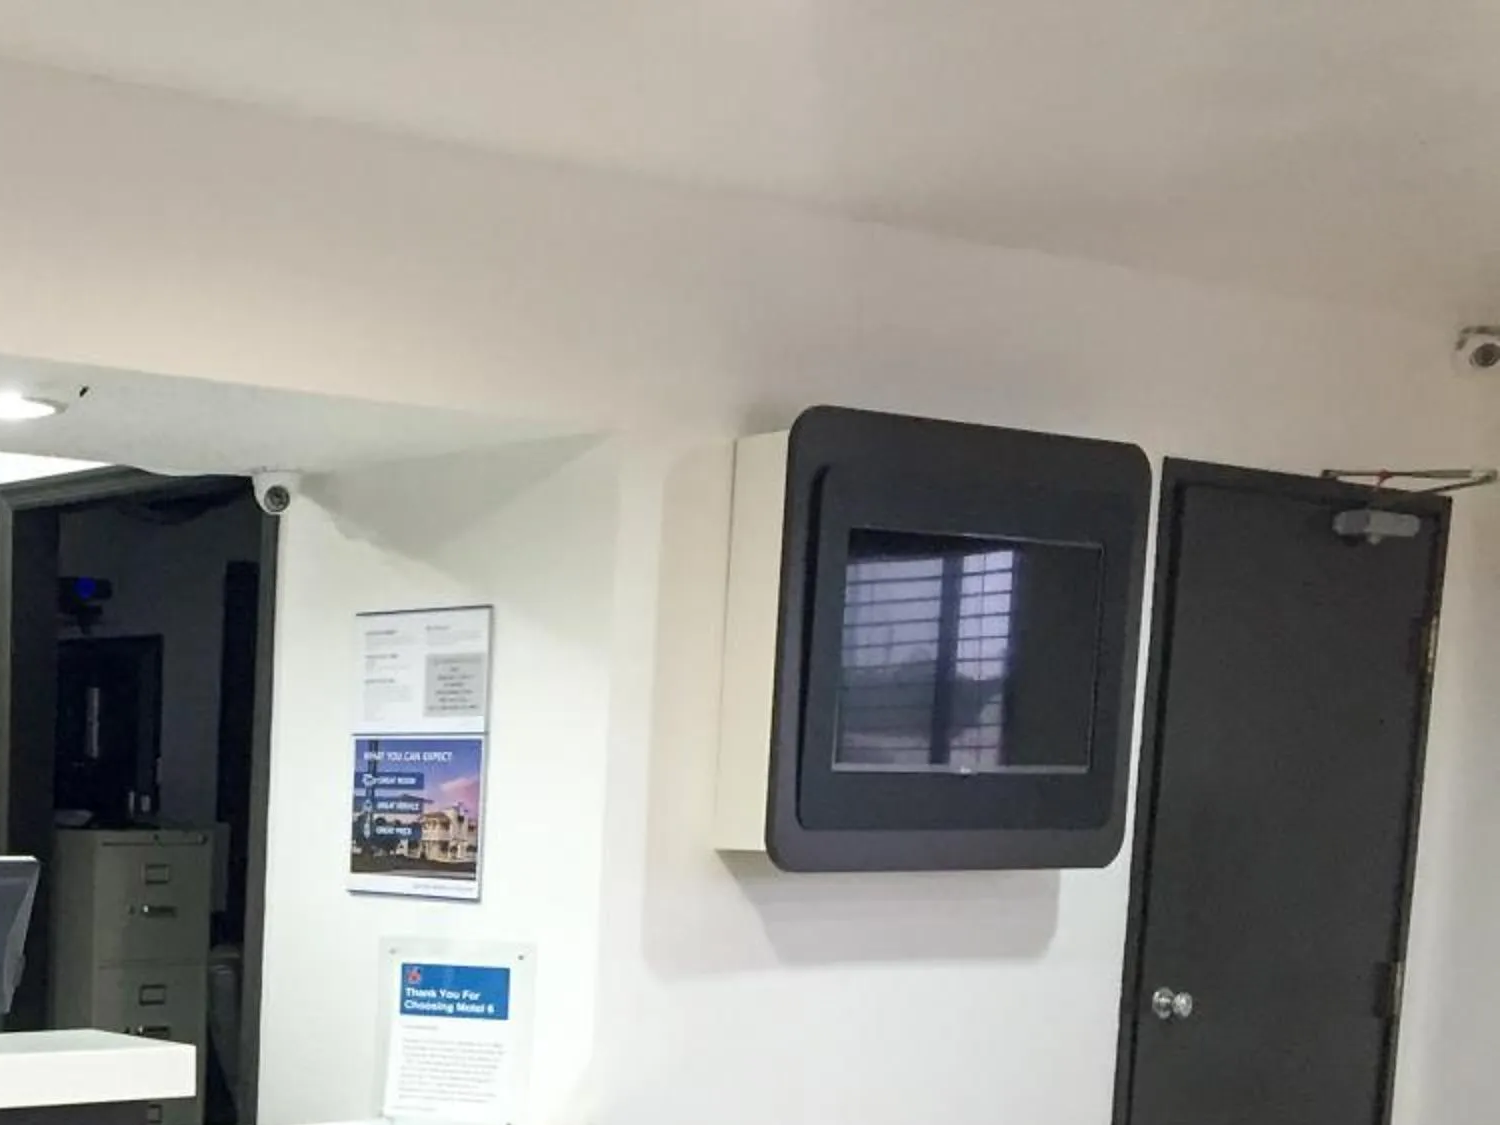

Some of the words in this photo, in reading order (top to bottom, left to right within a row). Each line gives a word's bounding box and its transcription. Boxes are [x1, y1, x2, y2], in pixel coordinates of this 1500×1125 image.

[403, 751, 421, 761] CAN
[422, 751, 453, 762] EXPECT
[405, 987, 437, 998] Thank
[439, 988, 461, 1000] You
[462, 989, 481, 1001] For
[404, 999, 454, 1015] Choosing
[456, 1002, 485, 1013] Motel
[487, 1003, 495, 1015] 6
